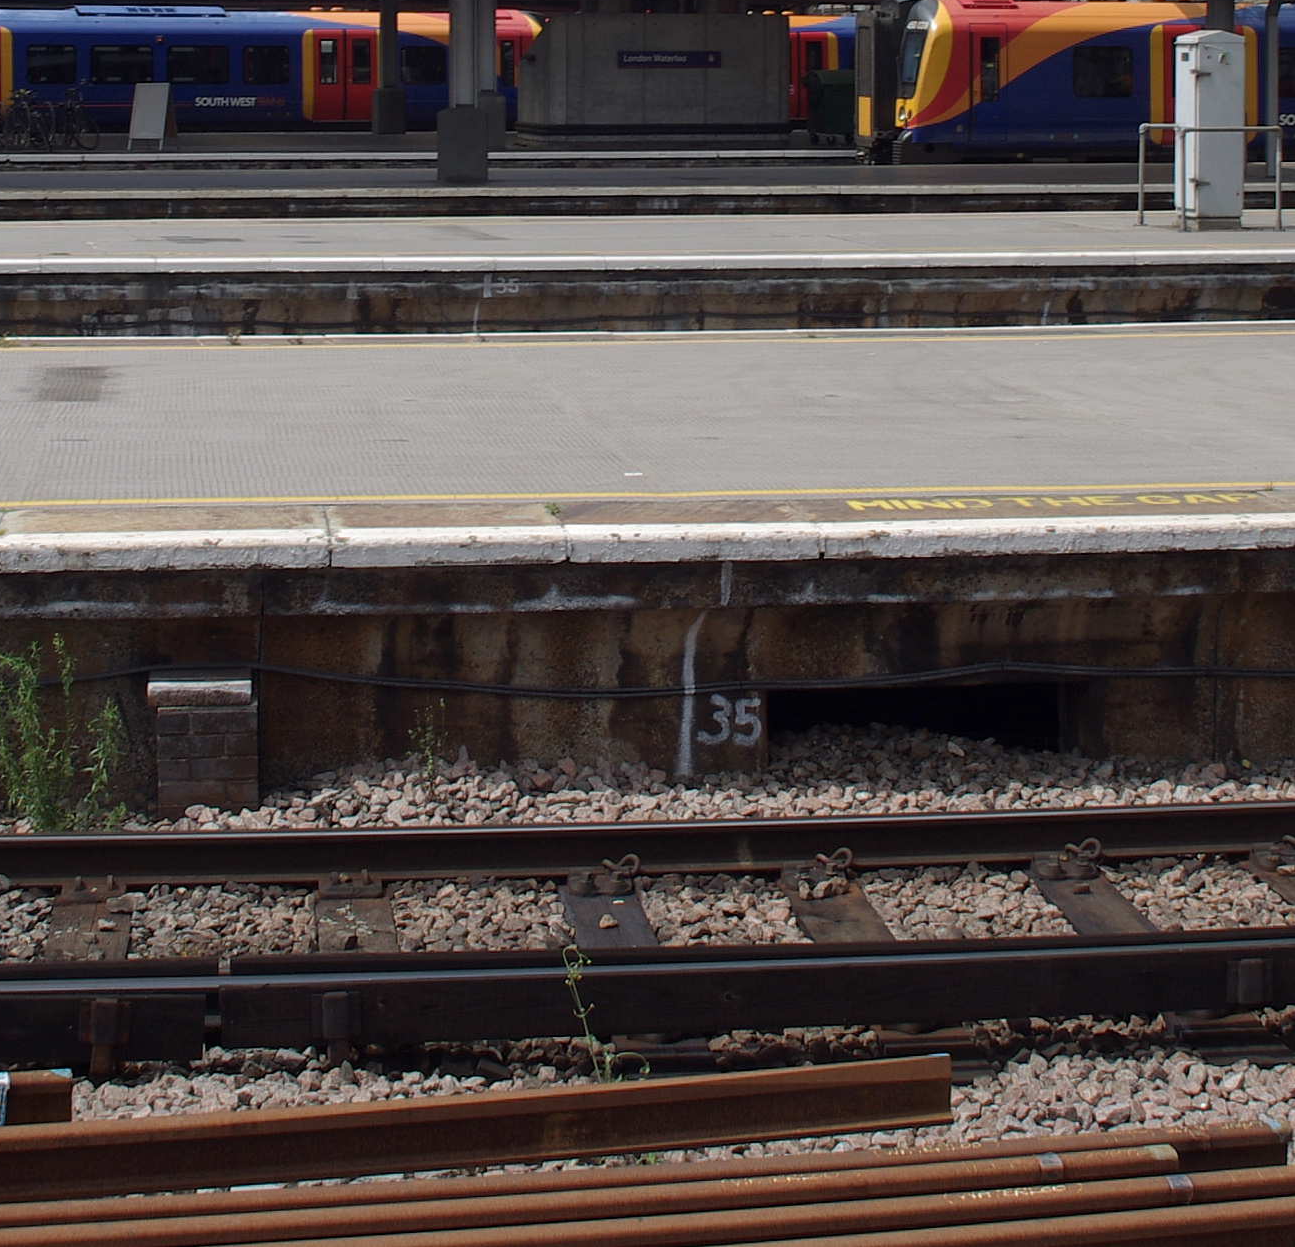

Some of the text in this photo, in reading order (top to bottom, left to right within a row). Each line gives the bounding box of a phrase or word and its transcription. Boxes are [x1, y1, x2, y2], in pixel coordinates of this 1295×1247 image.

[623, 54, 687, 63] London Waterloo
[194, 96, 229, 107] SOUTH
[229, 96, 257, 107] WEST
[845, 492, 1257, 511] MIND THE GAP
[697, 694, 762, 746] 35
